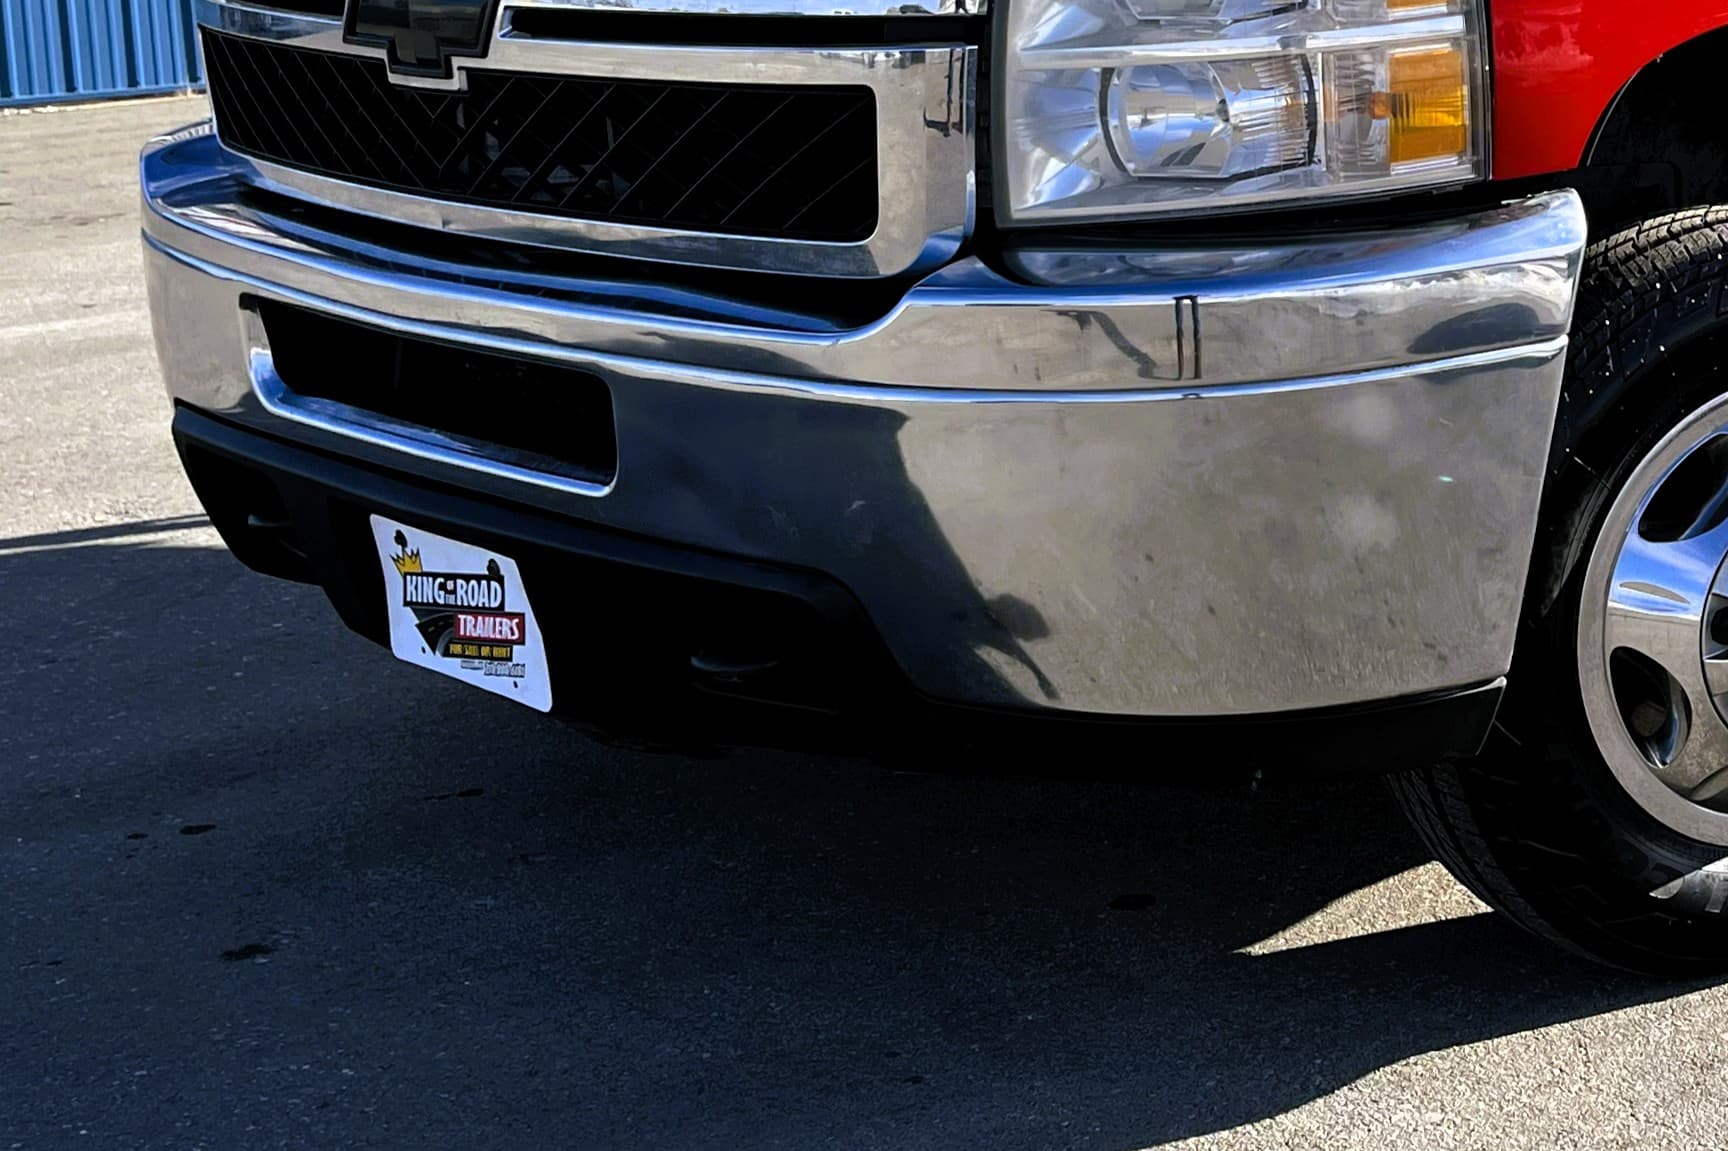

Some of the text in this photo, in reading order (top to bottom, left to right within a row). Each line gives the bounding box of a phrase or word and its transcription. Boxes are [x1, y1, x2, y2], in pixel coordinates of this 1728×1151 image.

[406, 575, 445, 604] KING
[456, 579, 502, 607] ROAD
[457, 614, 520, 641] TRAILERS
